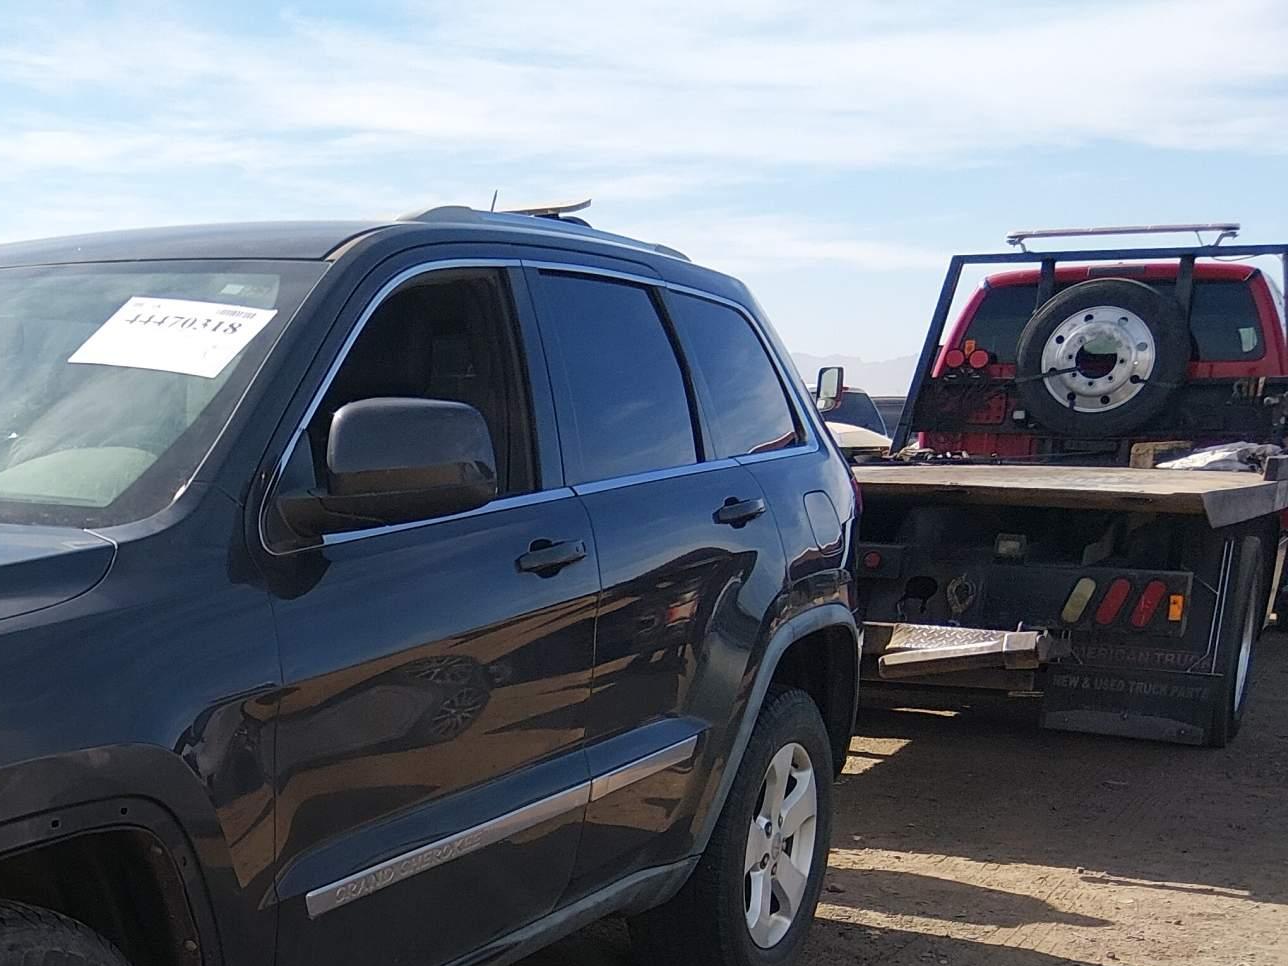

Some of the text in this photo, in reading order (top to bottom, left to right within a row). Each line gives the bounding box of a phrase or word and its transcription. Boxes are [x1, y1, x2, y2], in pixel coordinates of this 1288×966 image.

[125, 313, 243, 335] 44470318
[1094, 677, 1126, 692] USED
[1127, 681, 1168, 695] TRUCK
[335, 833, 482, 903] GRAND CHEROKEE
